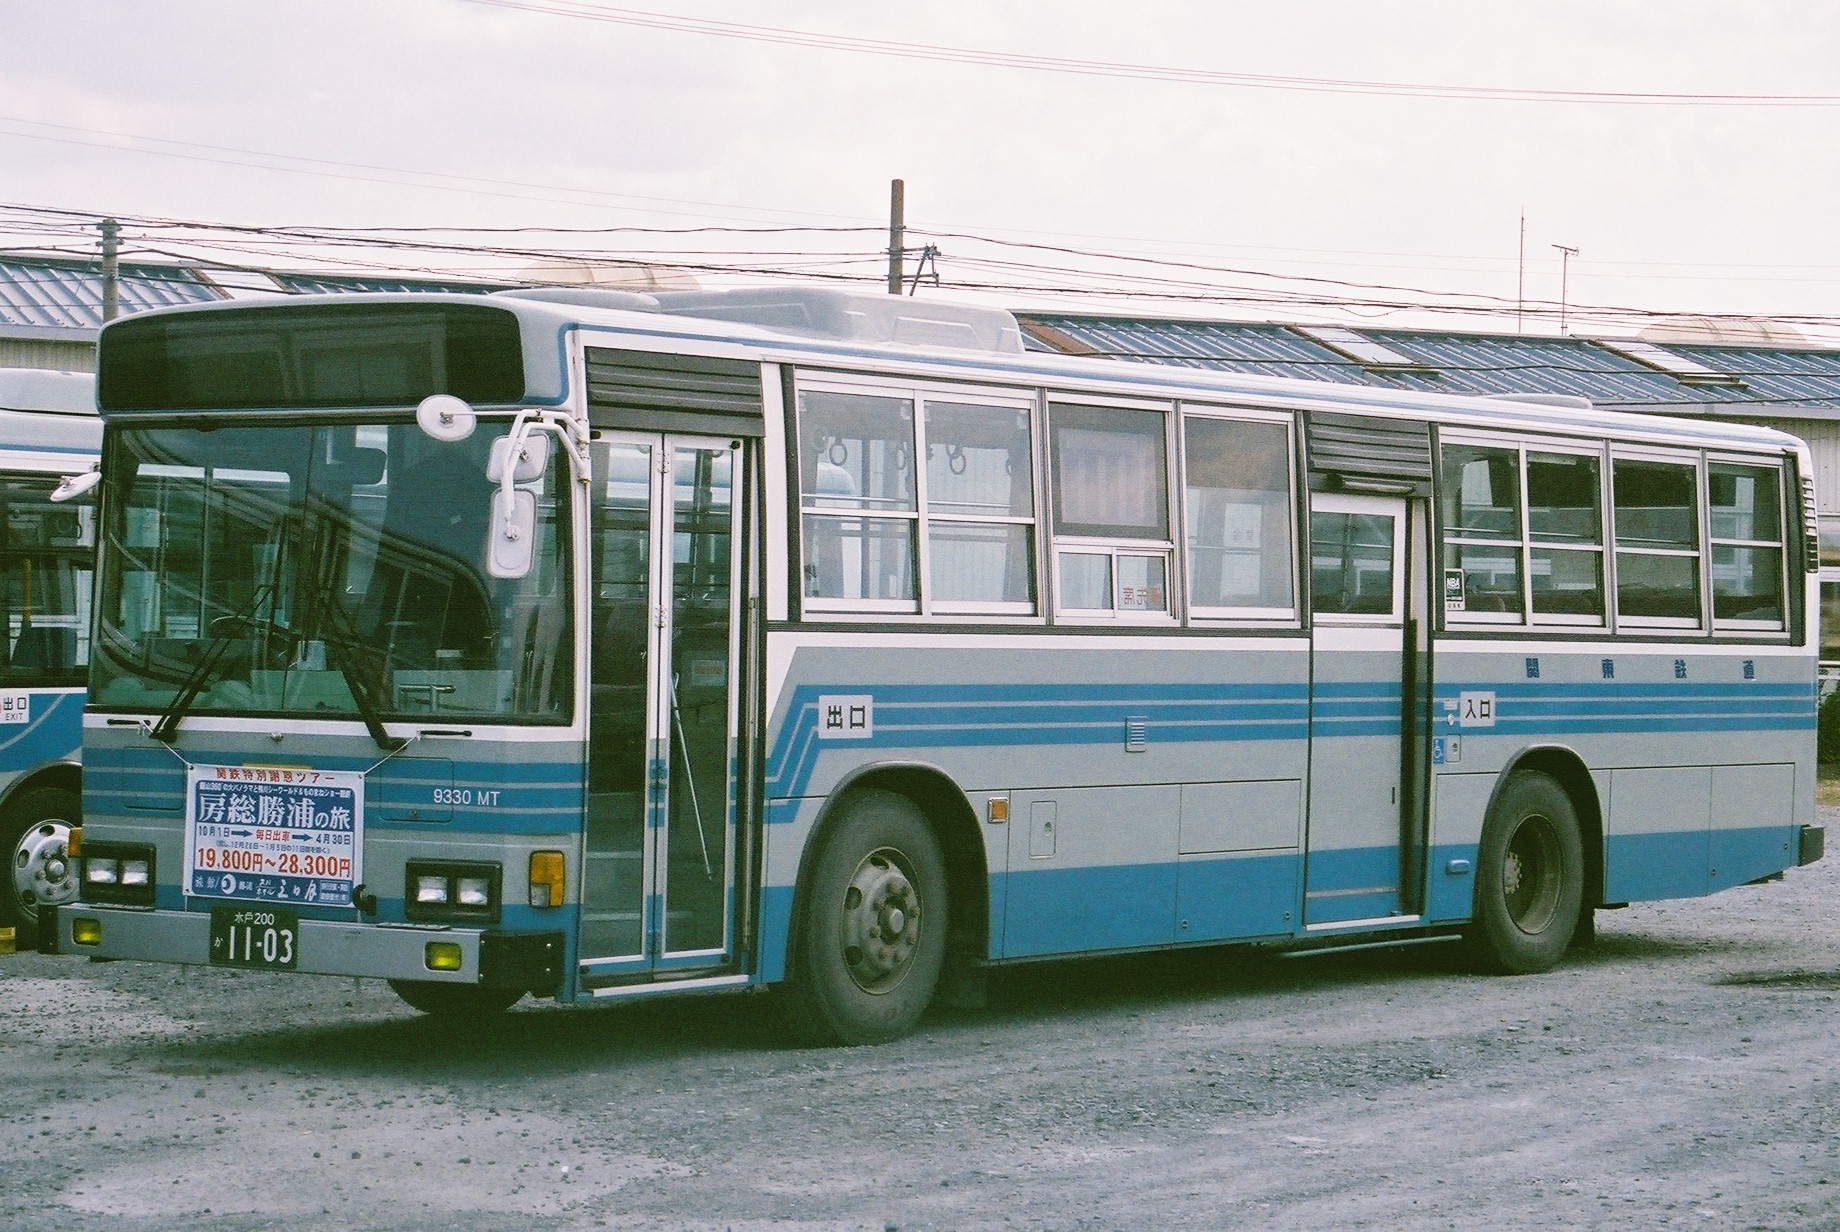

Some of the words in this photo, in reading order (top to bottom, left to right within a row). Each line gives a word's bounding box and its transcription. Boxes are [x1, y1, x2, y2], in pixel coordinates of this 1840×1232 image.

[3, 696, 27, 711] 出口
[1465, 699, 1490, 719] 入口
[5, 712, 23, 721] EXIT
[827, 705, 865, 729] 出口
[433, 788, 472, 805] 9330
[477, 790, 501, 806] MT
[198, 792, 351, 830] 房総勝浦の旅
[198, 825, 231, 838] 10月1日
[315, 833, 352, 846] 4月30日
[213, 936, 224, 948] か
[228, 925, 293, 964] 11-03
